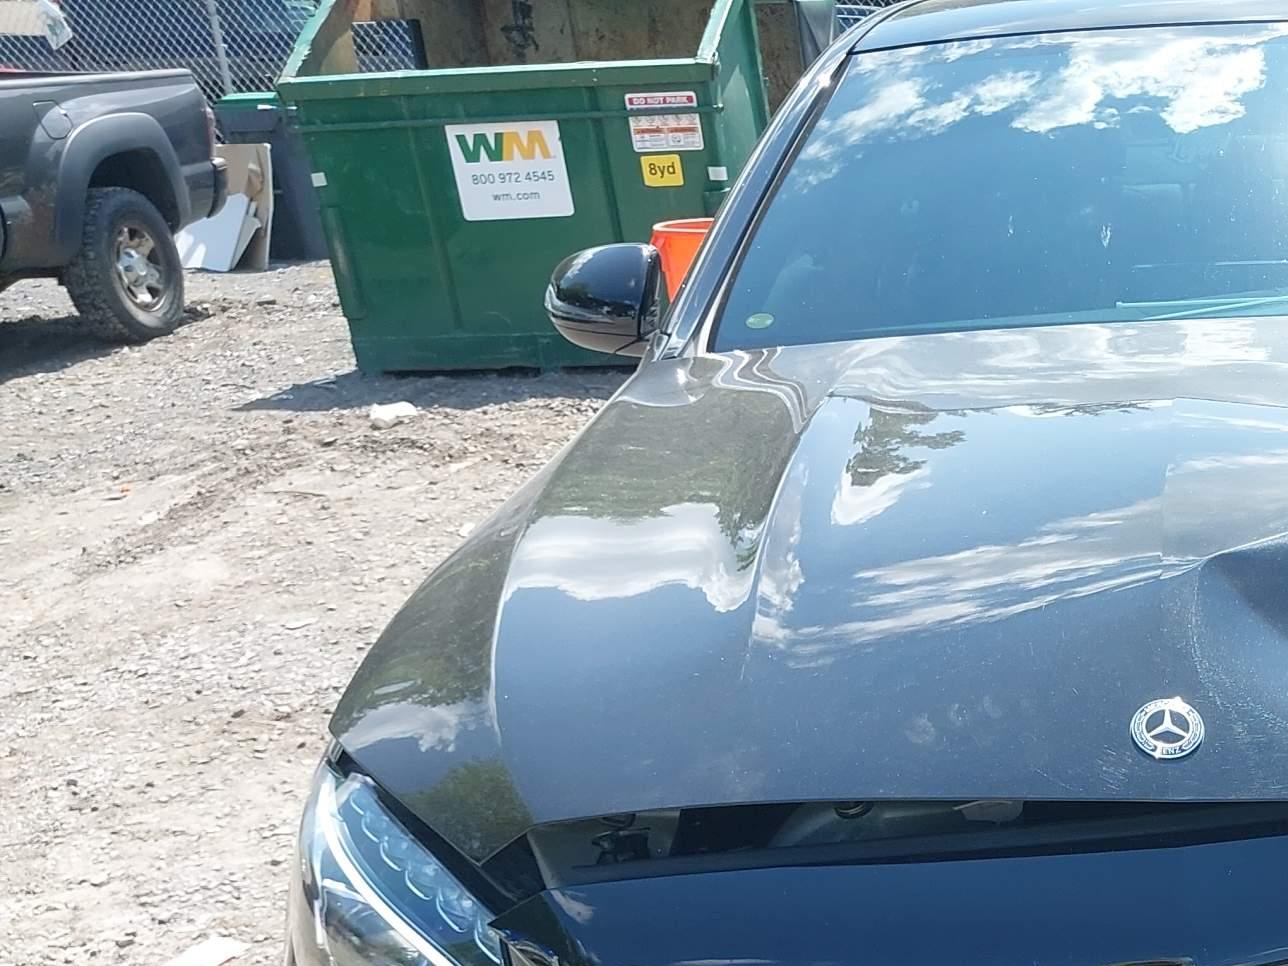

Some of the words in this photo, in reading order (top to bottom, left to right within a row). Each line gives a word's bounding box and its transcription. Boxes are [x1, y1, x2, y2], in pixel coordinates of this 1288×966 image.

[632, 97, 646, 105] DO
[647, 96, 665, 104] NOT
[455, 130, 552, 163] WM
[471, 174, 496, 185] 800
[498, 172, 521, 184] 972
[525, 170, 555, 182] 4545
[648, 162, 676, 178] 8yd
[492, 192, 540, 201] wm.com
